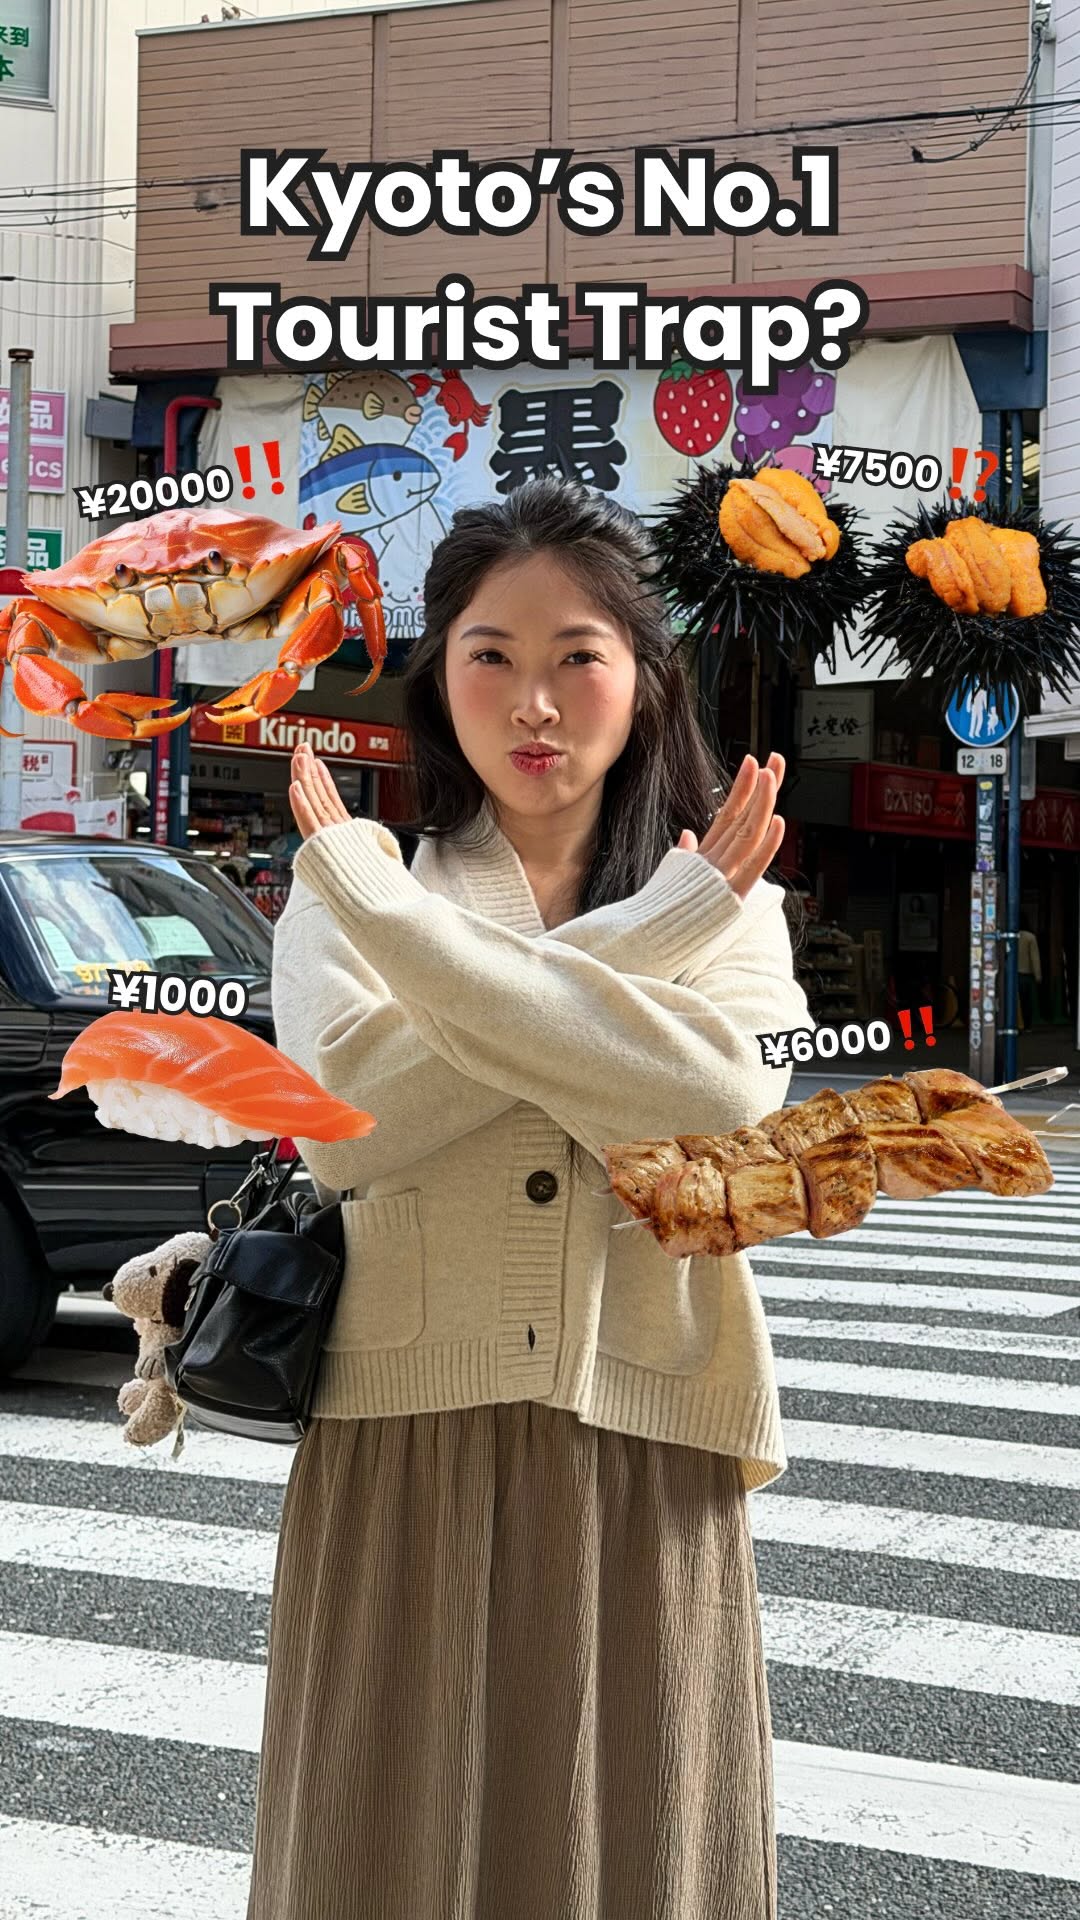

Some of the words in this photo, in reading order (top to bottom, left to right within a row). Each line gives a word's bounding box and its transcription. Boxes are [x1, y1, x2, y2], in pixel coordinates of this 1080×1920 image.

[259, 716, 356, 754] Kirindo
[961, 754, 975, 769] 12
[990, 753, 1003, 768] 18
